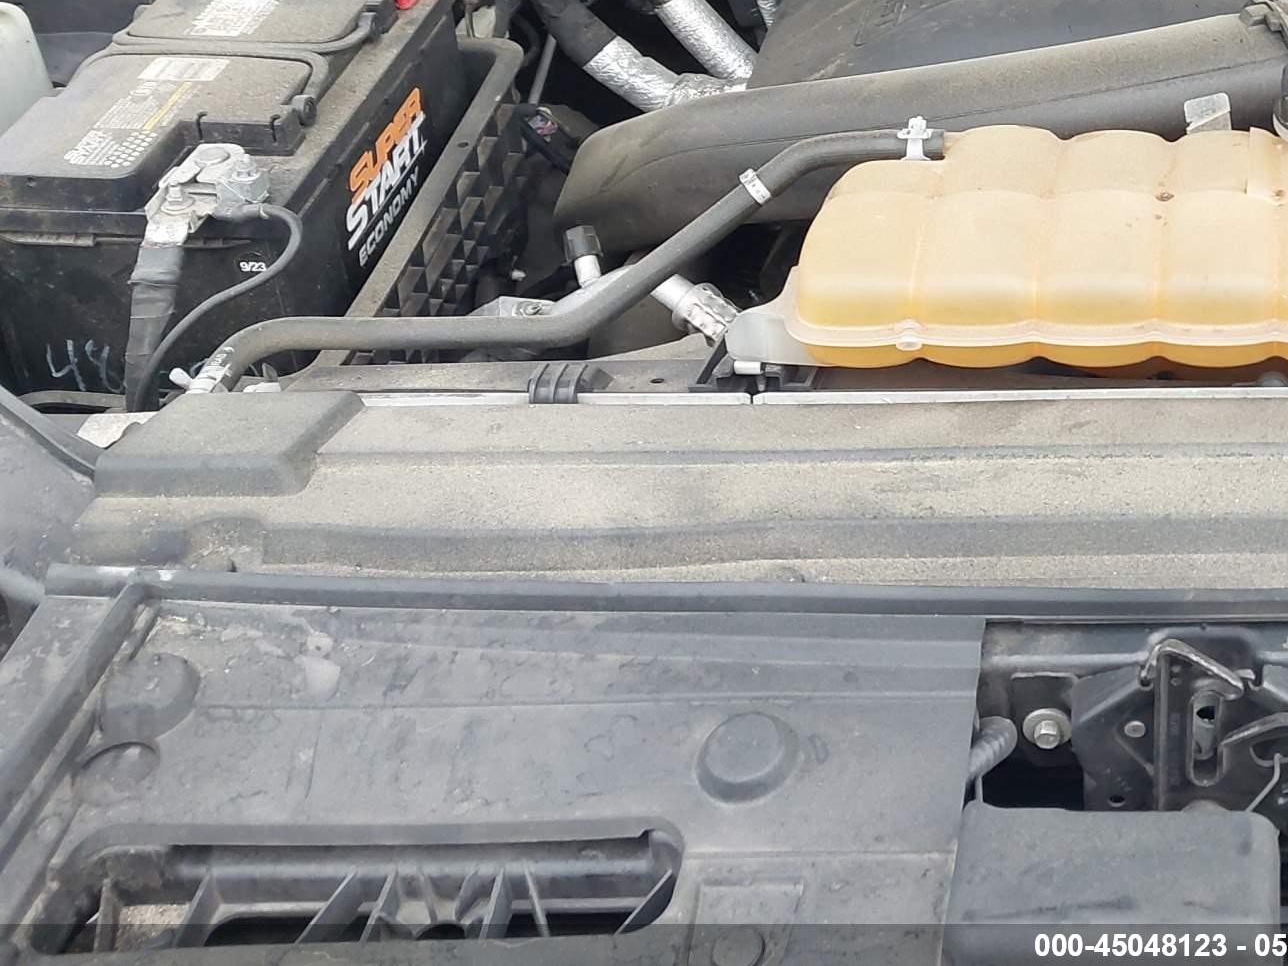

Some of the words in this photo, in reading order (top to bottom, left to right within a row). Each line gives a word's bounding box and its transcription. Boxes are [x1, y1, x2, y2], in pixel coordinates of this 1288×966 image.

[346, 110, 426, 250] START
[347, 87, 421, 205] SUPER
[239, 261, 267, 272] 9/23
[358, 165, 420, 267] ECONOMY
